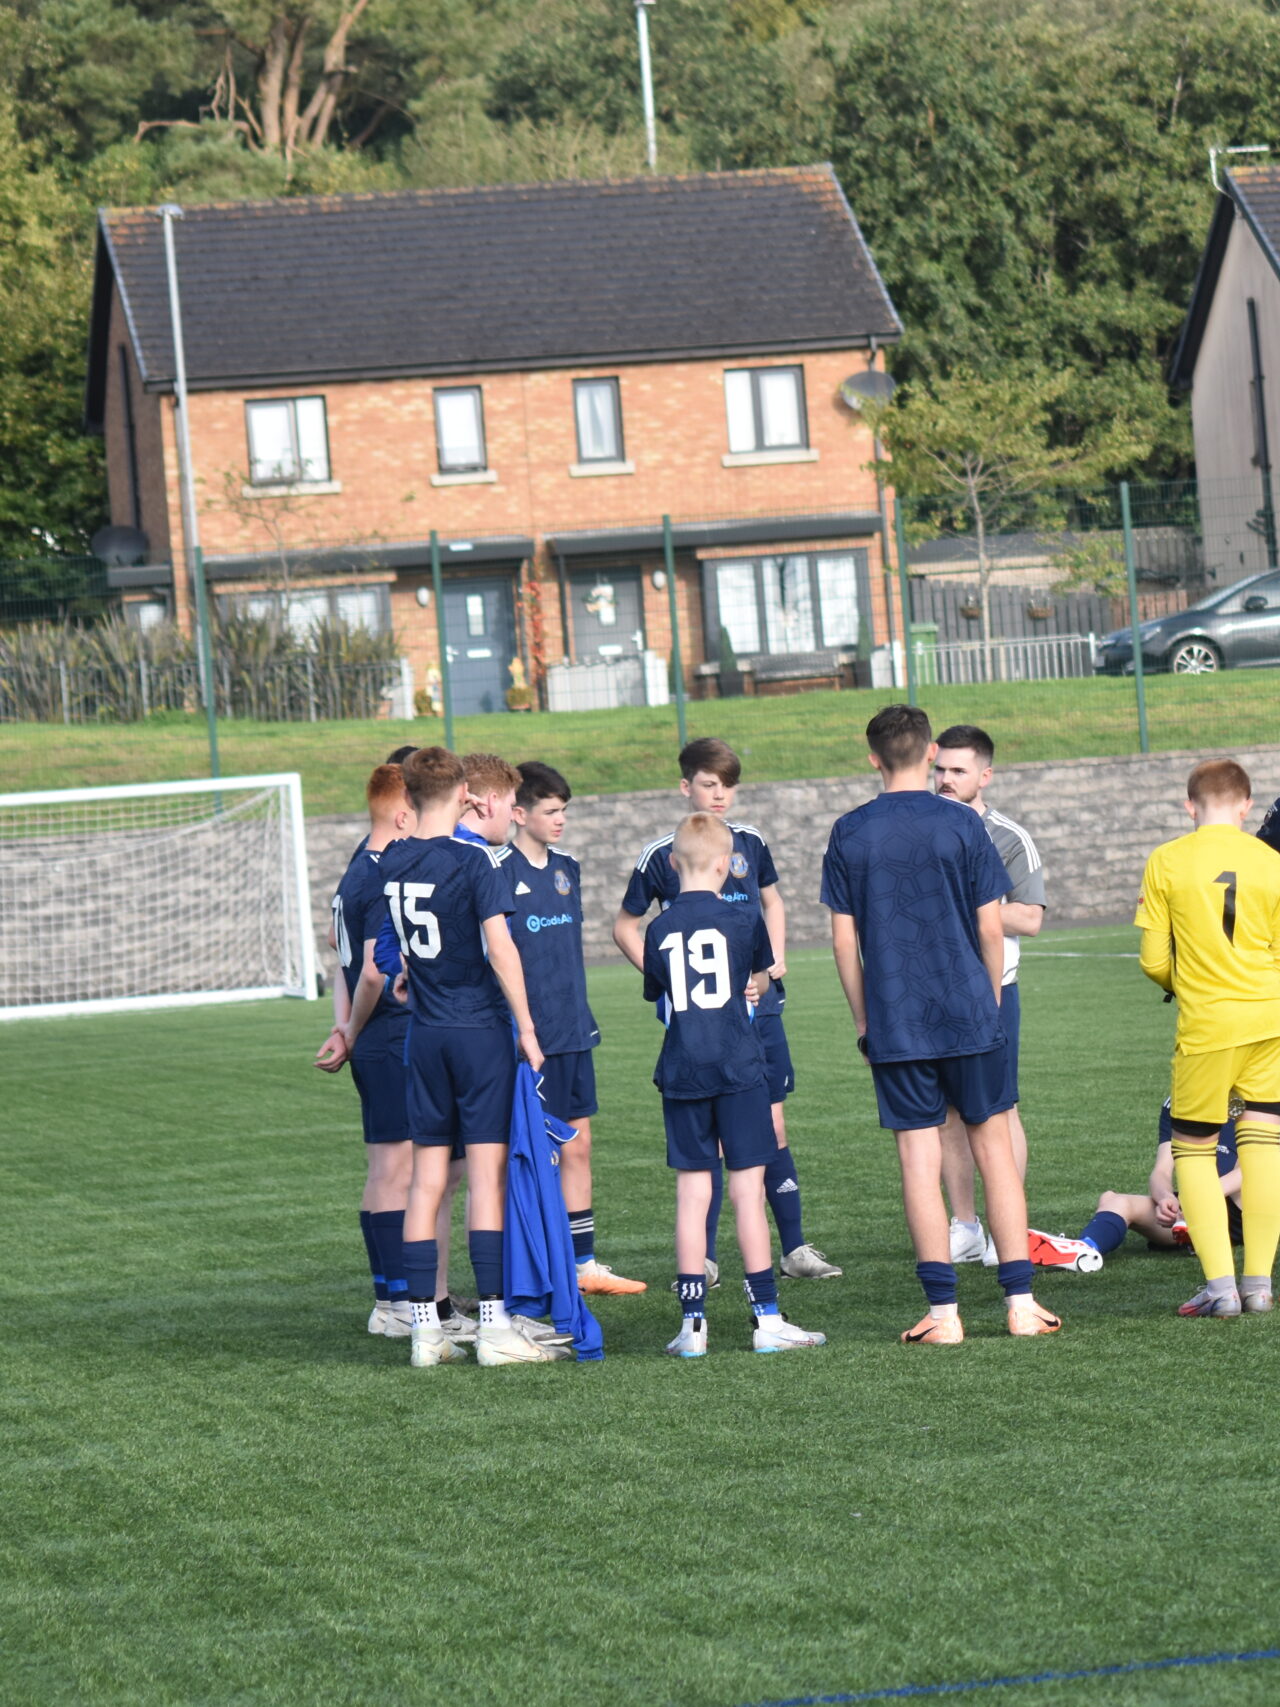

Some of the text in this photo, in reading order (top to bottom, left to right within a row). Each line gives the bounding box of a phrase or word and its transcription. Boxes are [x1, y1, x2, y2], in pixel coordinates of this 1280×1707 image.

[383, 881, 442, 959] 15
[1212, 870, 1237, 948] 1
[658, 928, 732, 1012] 19
